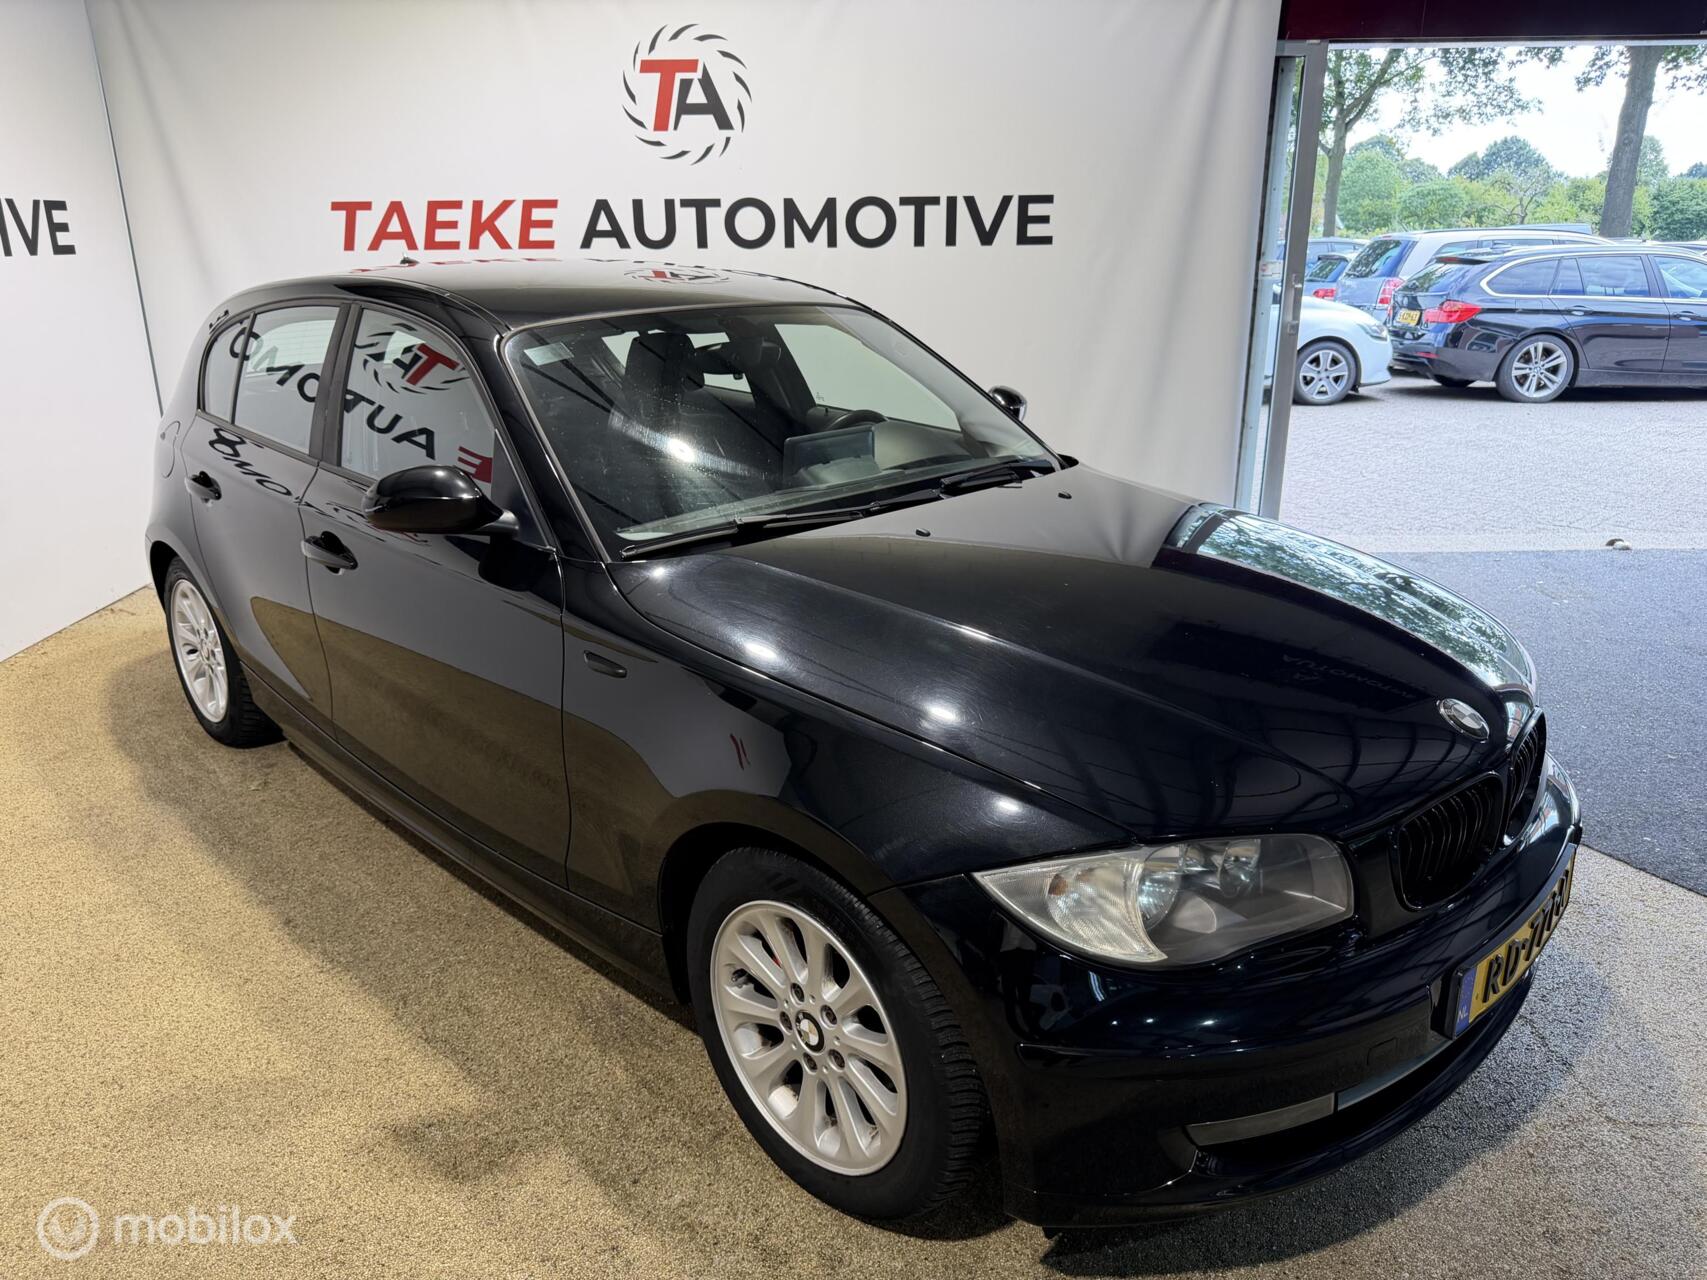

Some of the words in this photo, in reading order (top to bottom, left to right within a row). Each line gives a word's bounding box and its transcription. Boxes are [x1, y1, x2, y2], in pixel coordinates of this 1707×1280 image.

[639, 58, 735, 132] TA
[331, 198, 558, 251] TAEKE
[581, 194, 1055, 250] AUTOMOTIVE
[1457, 1005, 1469, 1023] NL
